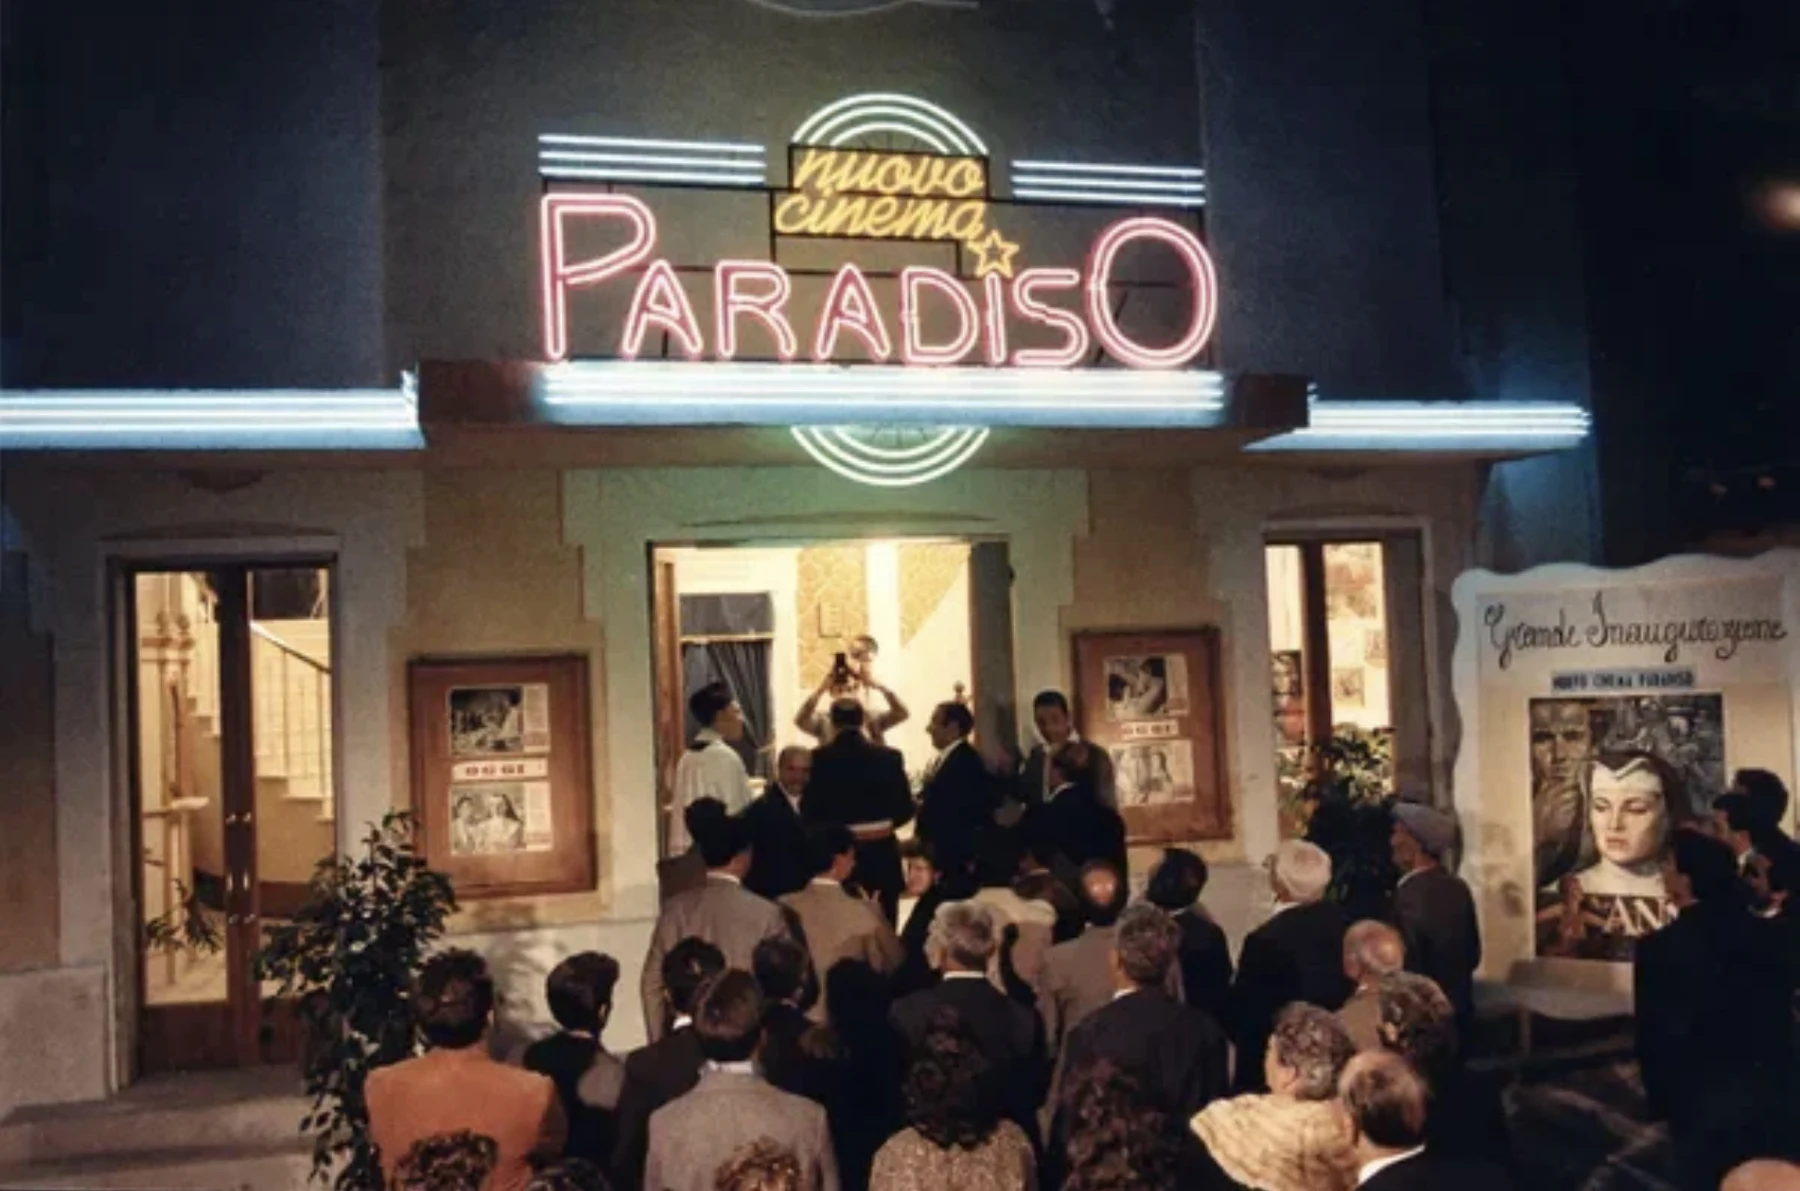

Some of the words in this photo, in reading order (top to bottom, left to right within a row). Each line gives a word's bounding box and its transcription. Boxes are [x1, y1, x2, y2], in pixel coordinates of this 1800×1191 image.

[792, 147, 985, 198] nuovo
[773, 195, 987, 242] cinema
[540, 192, 1219, 368] PARADISO
